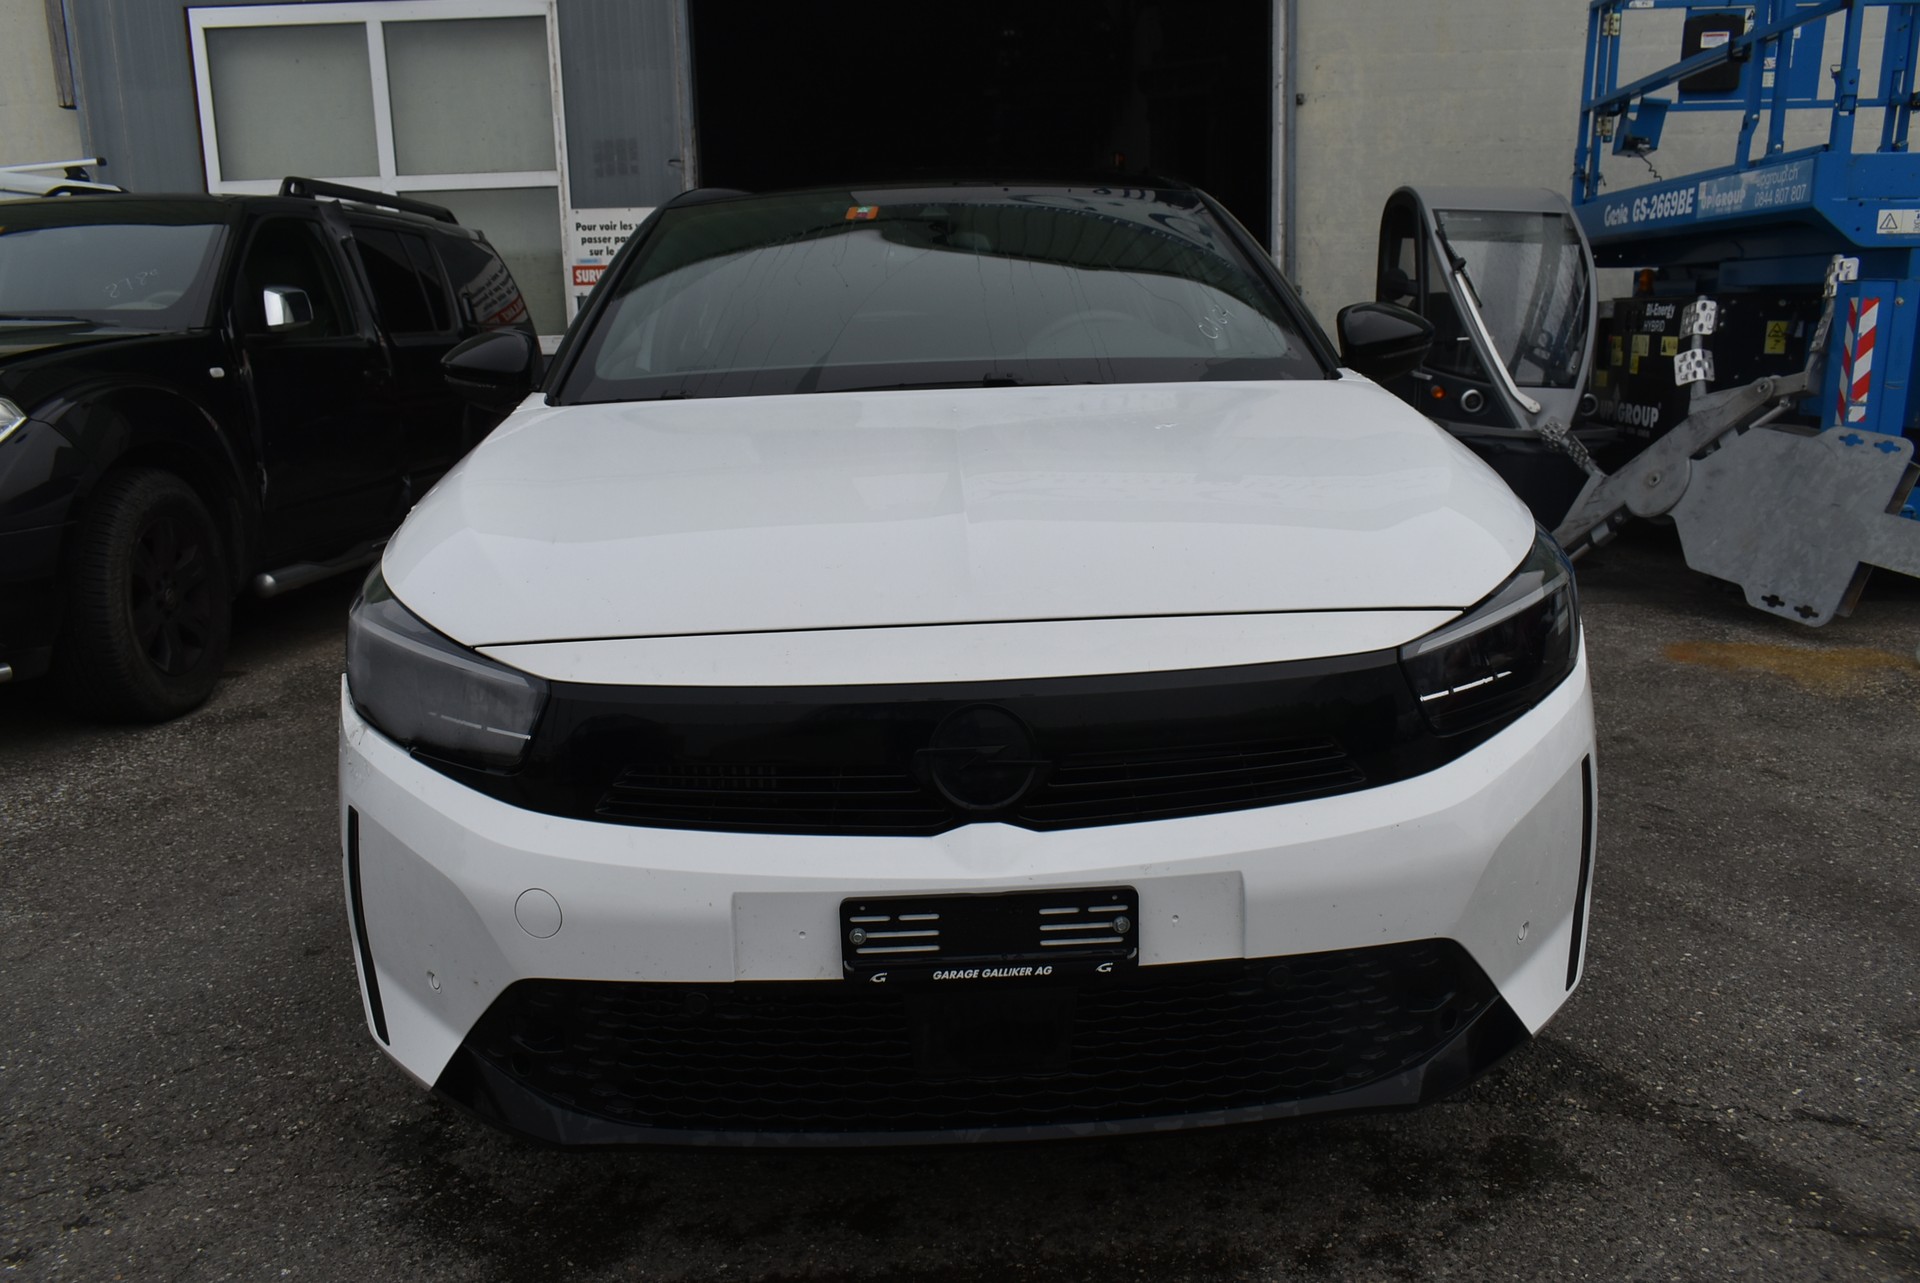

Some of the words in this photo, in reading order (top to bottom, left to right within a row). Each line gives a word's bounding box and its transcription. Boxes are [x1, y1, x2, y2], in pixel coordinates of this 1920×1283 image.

[1632, 187, 1696, 224] GS-2669BE
[575, 222, 597, 231] Pour
[599, 221, 617, 231] voir
[620, 221, 633, 231] les
[581, 236, 612, 245] passer
[606, 246, 615, 256] le
[932, 968, 980, 980] GARAGE
[981, 966, 1033, 978] GALLIKER
[1035, 966, 1053, 976] AG
